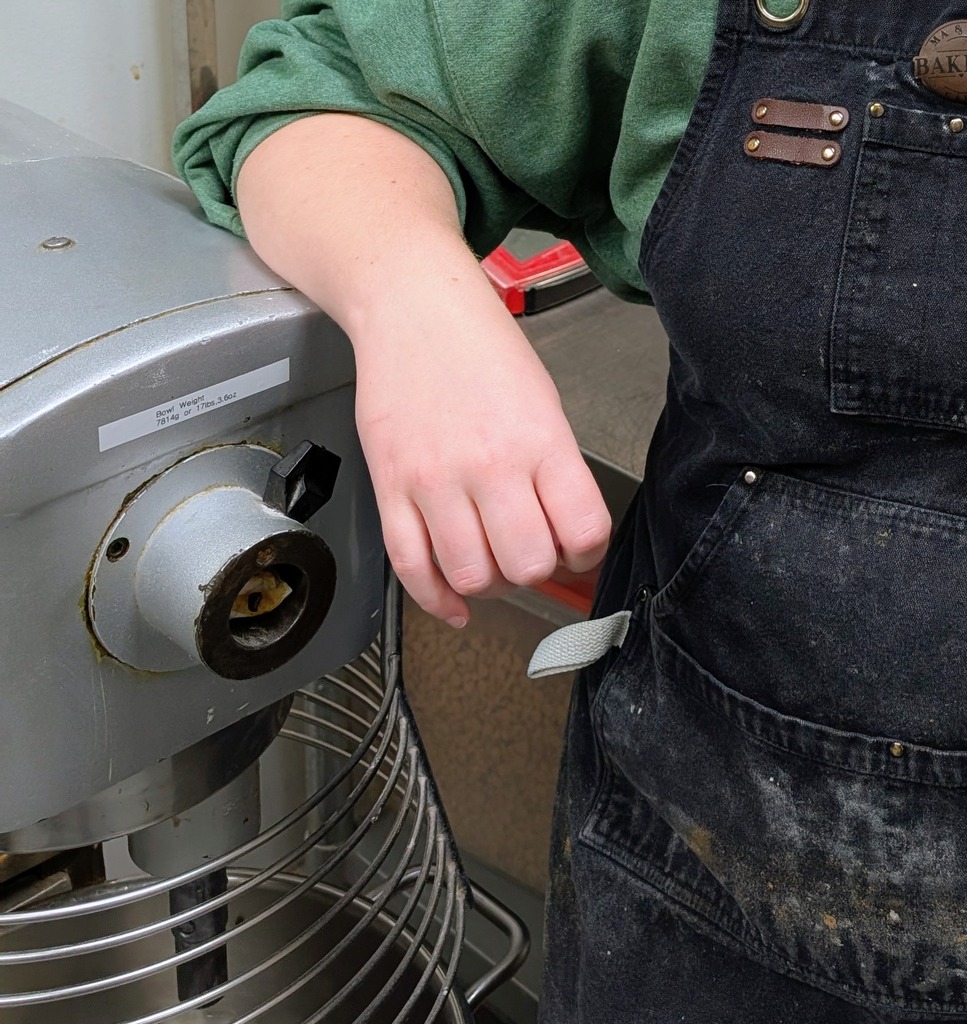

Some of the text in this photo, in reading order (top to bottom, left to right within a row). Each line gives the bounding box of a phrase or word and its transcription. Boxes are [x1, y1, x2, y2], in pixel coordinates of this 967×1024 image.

[930, 30, 949, 46] MA
[954, 24, 963, 35] &
[156, 395, 205, 418] Bowl Weight
[156, 412, 180, 427] 7814g
[183, 408, 192, 417] or
